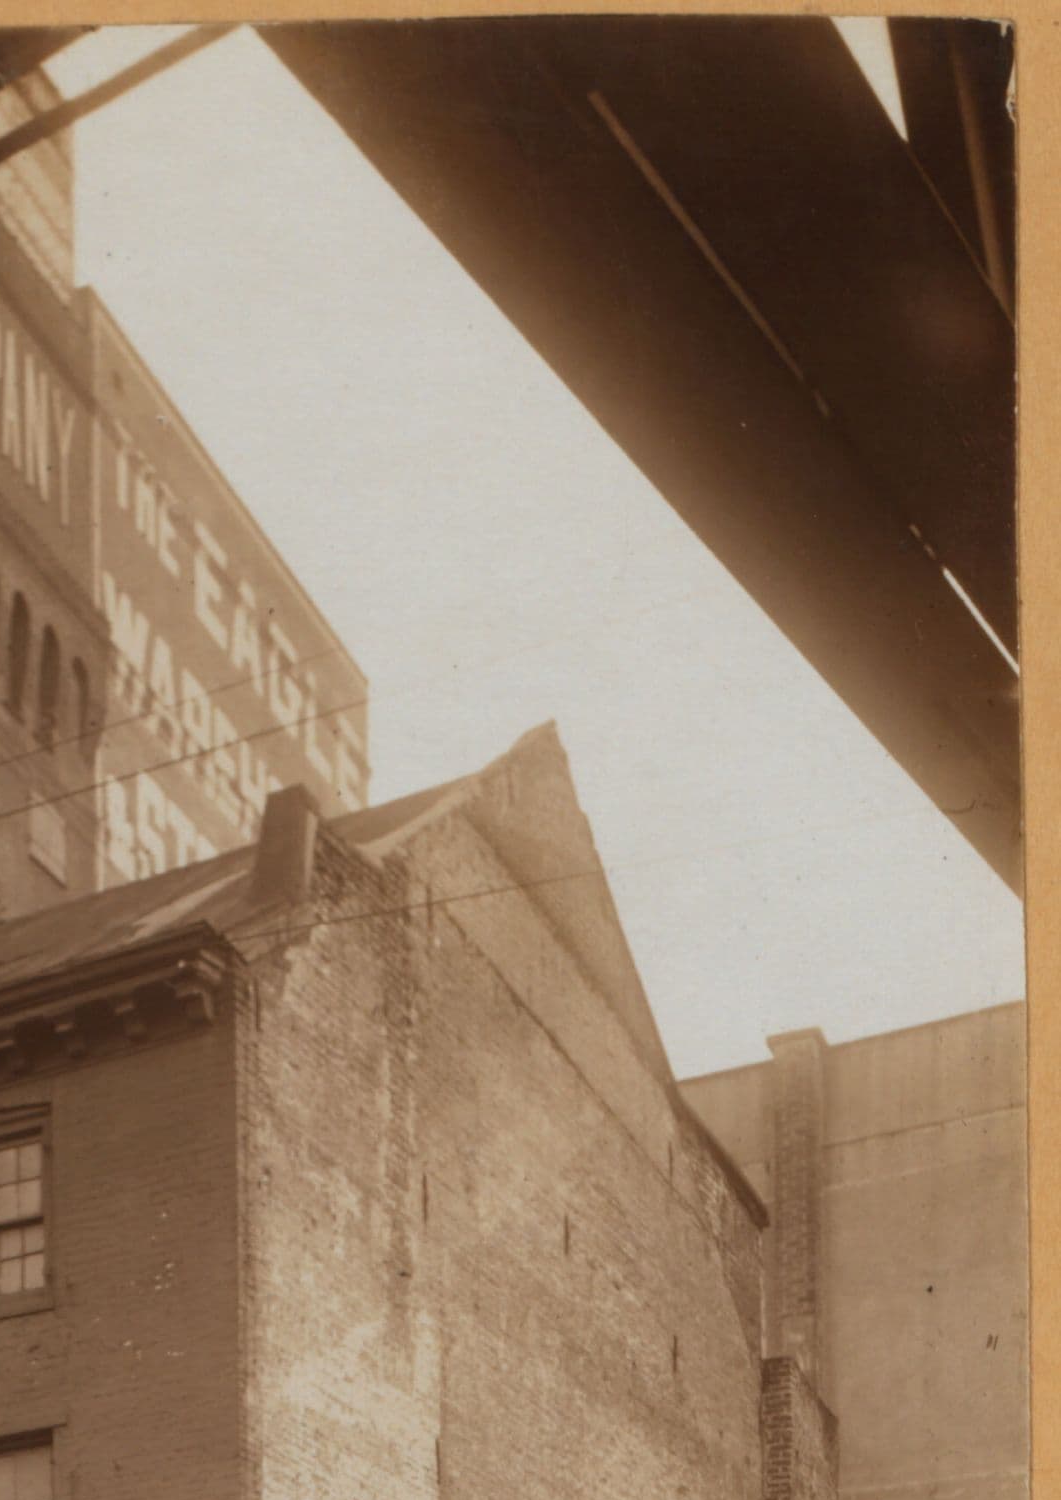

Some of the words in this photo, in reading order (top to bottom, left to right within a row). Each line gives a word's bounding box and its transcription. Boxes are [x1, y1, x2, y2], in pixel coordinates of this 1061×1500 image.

[102, 570, 283, 842] WAREH
[113, 418, 181, 578] THE
[194, 520, 363, 813] EAGLE
